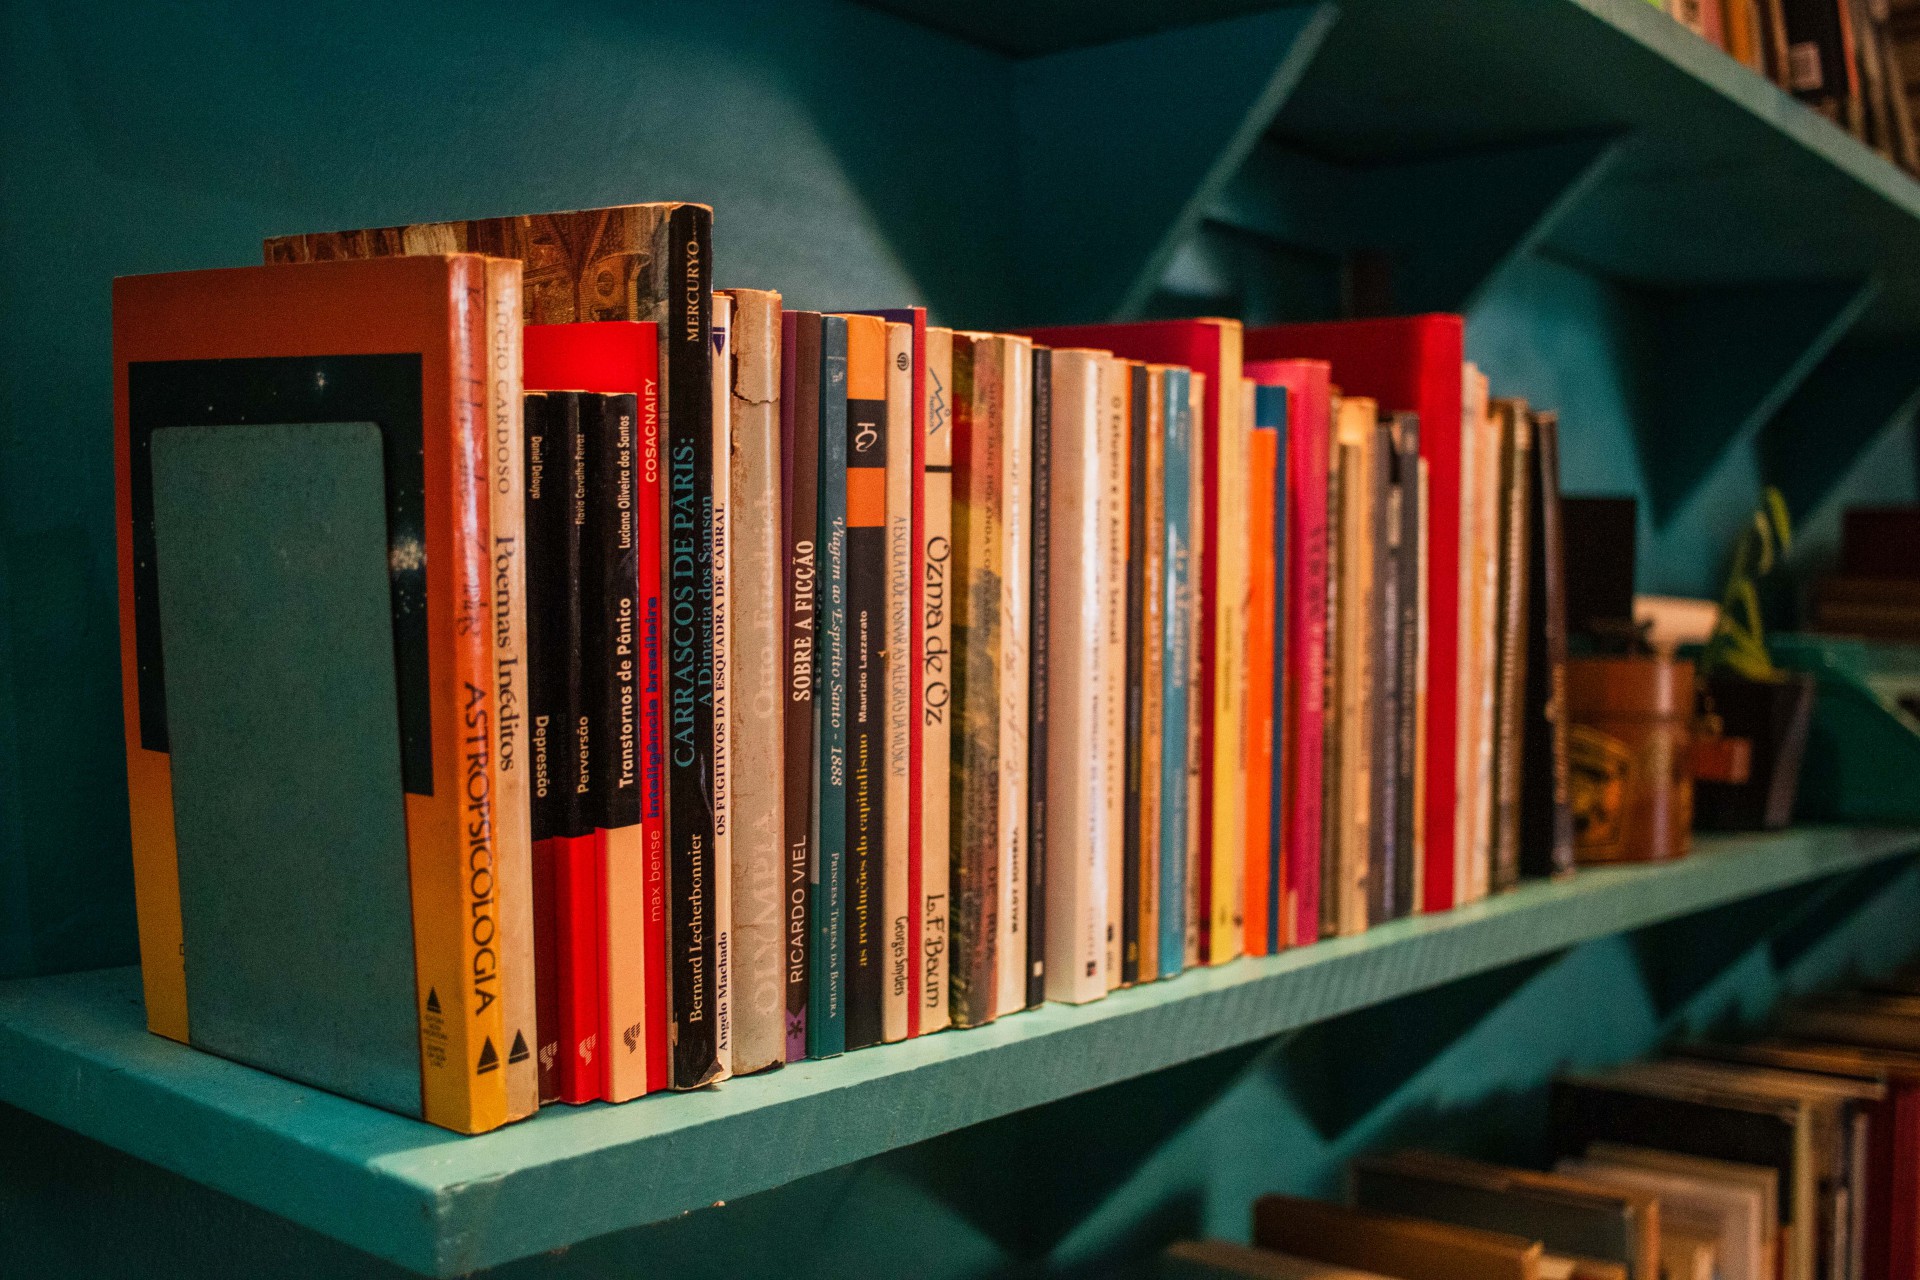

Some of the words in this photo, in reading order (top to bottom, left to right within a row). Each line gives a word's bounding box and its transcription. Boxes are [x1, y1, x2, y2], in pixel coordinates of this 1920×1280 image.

[686, 241, 700, 342] MERCURYO
[496, 380, 511, 494] CARDOSO
[530, 436, 543, 465] Daniel
[575, 434, 585, 459] Ferraz
[617, 415, 630, 448] Santos
[645, 378, 657, 483] COSACNAIFY
[574, 459, 585, 499] Carvalho
[617, 451, 630, 468] dos
[673, 437, 695, 530] PARIS:
[618, 469, 630, 509] Oliveira
[618, 512, 631, 549] Luciana
[698, 495, 713, 563] Sanson
[715, 503, 725, 571] CABRAL
[824, 516, 843, 581] Viagem
[893, 526, 907, 567] ESCOLA
[673, 537, 695, 579] DE
[792, 540, 815, 612] FICÇÃO
[893, 568, 907, 598] PODE
[926, 535, 950, 631] Ozma
[495, 536, 516, 648] Poemas
[698, 573, 713, 600] dos
[715, 574, 725, 598] DE
[832, 583, 841, 604] ao
[616, 597, 632, 656] Pânico
[645, 597, 658, 693] brasileira
[697, 603, 713, 686] Dinastia
[714, 602, 727, 692] ESQUADRA
[794, 616, 812, 630] A
[858, 610, 868, 666] Lazzarato
[893, 600, 907, 645] ENSINAR
[617, 660, 632, 681] de
[673, 586, 696, 767] CARRASCOS
[793, 636, 812, 702] SOBRE
[925, 635, 948, 675] de
[698, 693, 712, 707] A
[716, 696, 726, 718] DA
[831, 680, 843, 729] Santo
[858, 671, 868, 723] Maurizio
[892, 663, 907, 712] ALEGRIAS
[925, 681, 950, 726] Oz
[498, 657, 520, 772] Inéditos
[618, 686, 634, 788] Transtornos
[532, 715, 550, 798] Depressão
[577, 716, 589, 794] Perversão
[646, 699, 662, 818] inteligência
[716, 722, 726, 813] FUGITIVOS
[831, 747, 843, 787] 1888
[856, 733, 871, 831] capitalismo
[464, 681, 497, 1017] ASTROPSICOLOGIA
[717, 814, 726, 836] OS
[856, 835, 867, 854] do
[649, 830, 661, 882] bense
[792, 834, 806, 884] VIEL
[650, 886, 661, 922] max
[687, 833, 703, 951] Lecherbonnier
[752, 808, 779, 1016] OLYMPIA
[856, 858, 867, 944] revoluções
[790, 888, 806, 984] RICARDO
[859, 950, 867, 967] as
[892, 915, 908, 956] Georges
[689, 956, 703, 1023] Bernard
[718, 931, 728, 1000] Machado
[891, 956, 908, 996] Snyders
[926, 935, 945, 1009] Baum
[717, 1002, 728, 1051] Angelo
